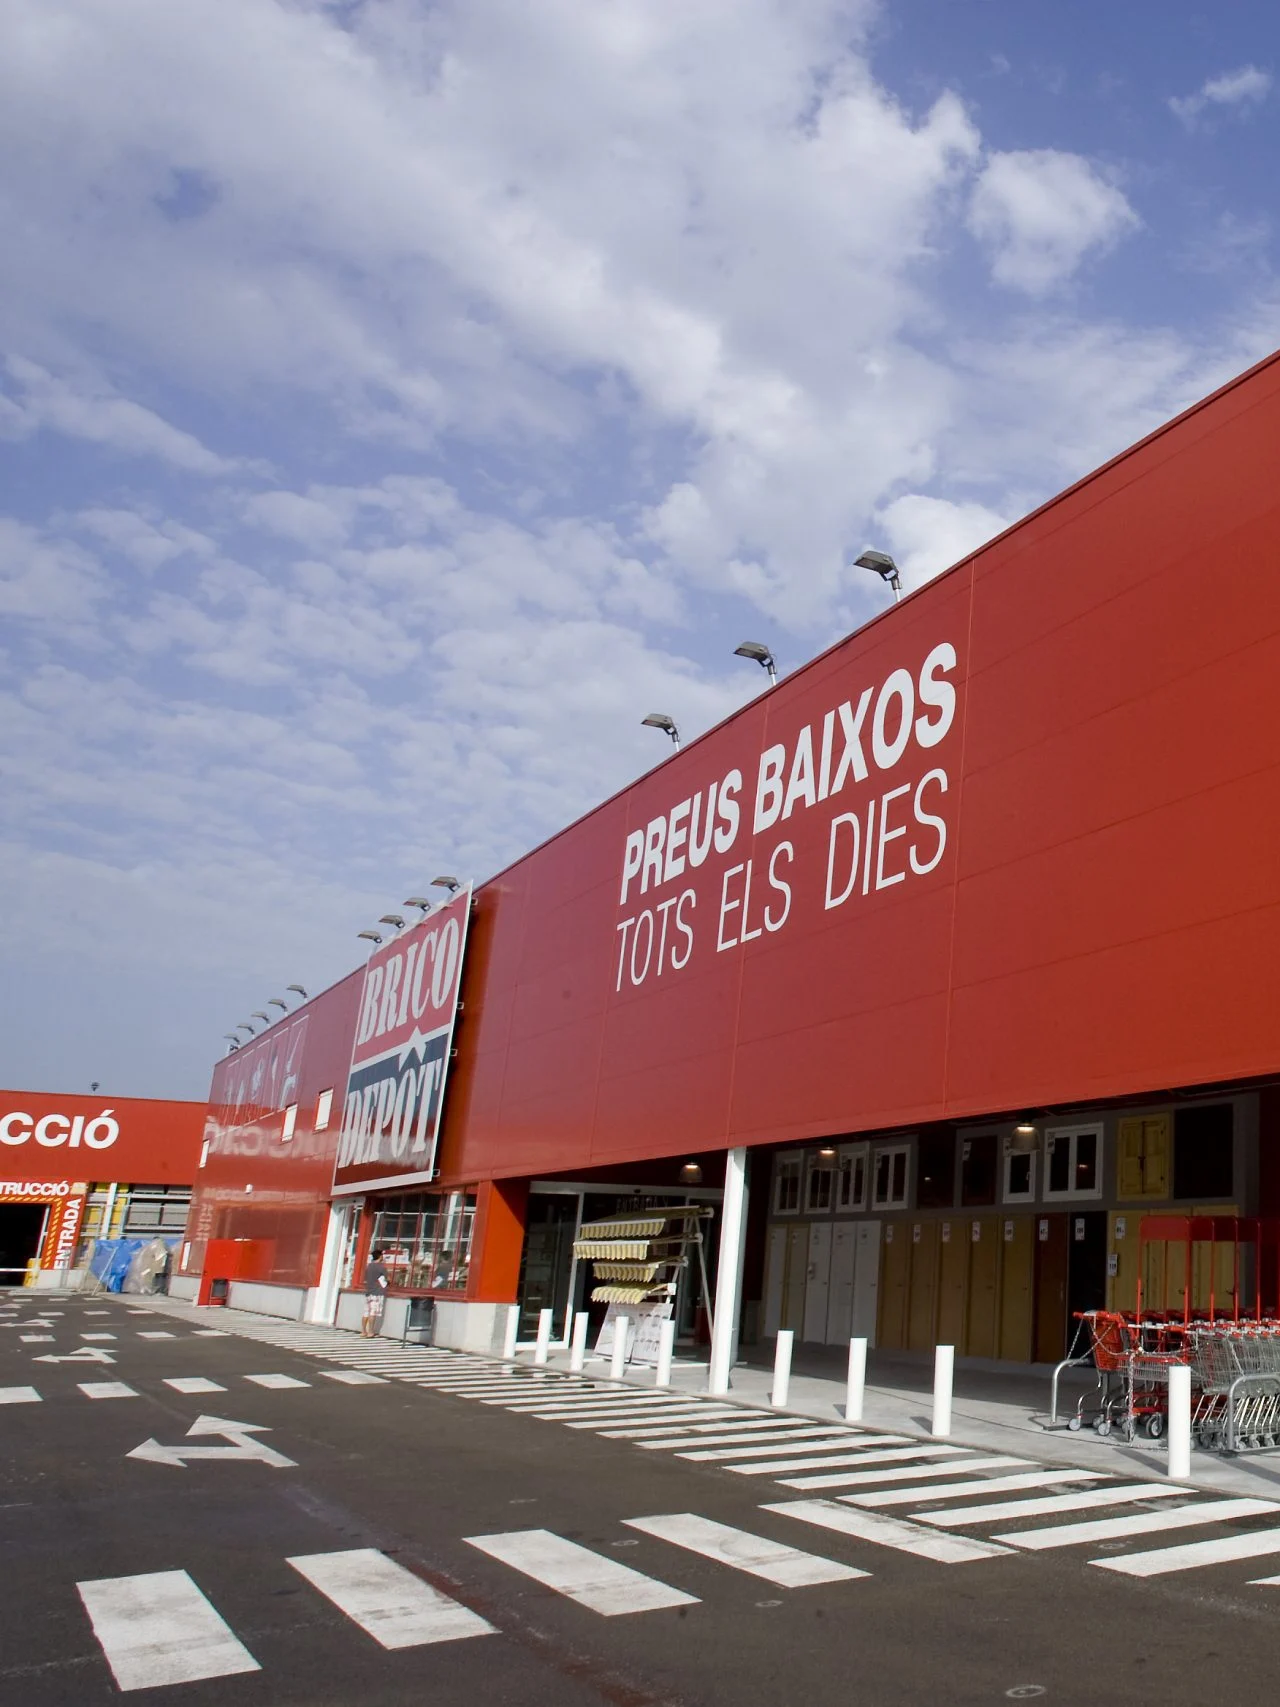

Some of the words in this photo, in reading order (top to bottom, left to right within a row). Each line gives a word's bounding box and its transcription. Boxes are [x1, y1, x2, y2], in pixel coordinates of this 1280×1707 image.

[620, 768, 742, 906] PREUS
[753, 642, 957, 836] BAIXOS
[616, 888, 696, 992] TOTS
[716, 841, 794, 952] ELS
[825, 768, 948, 910] DIES
[357, 917, 460, 1046] BRICO
[0, 1109, 119, 1149] CCIÓ
[54, 1198, 82, 1270] ENTRADA
